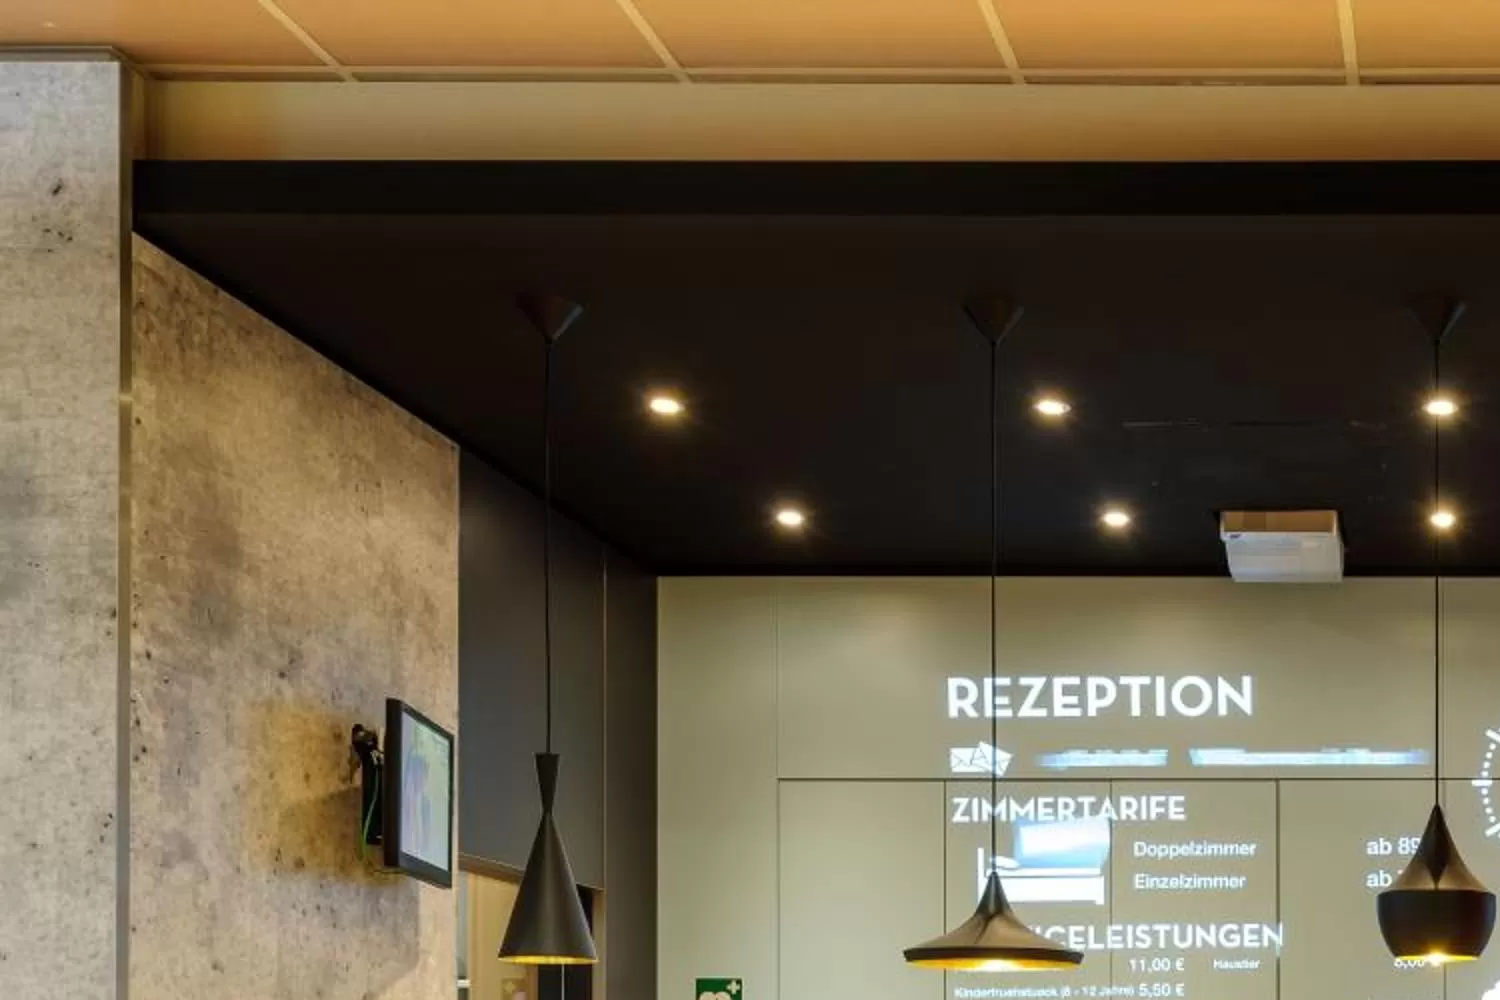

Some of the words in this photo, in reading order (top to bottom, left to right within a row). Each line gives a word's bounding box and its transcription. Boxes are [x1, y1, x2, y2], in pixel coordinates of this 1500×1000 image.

[947, 675, 1253, 718] REZEPTION
[952, 796, 1187, 823] ZIMMERTARIFE
[1133, 841, 1256, 859] Doppelzimmer
[1366, 838, 1392, 855] ab
[1134, 874, 1246, 889] Einzelzimmer
[1366, 871, 1392, 887] ab
[1028, 923, 1284, 949] CELEISTUNGEN
[1138, 983, 1171, 998] 5,50
